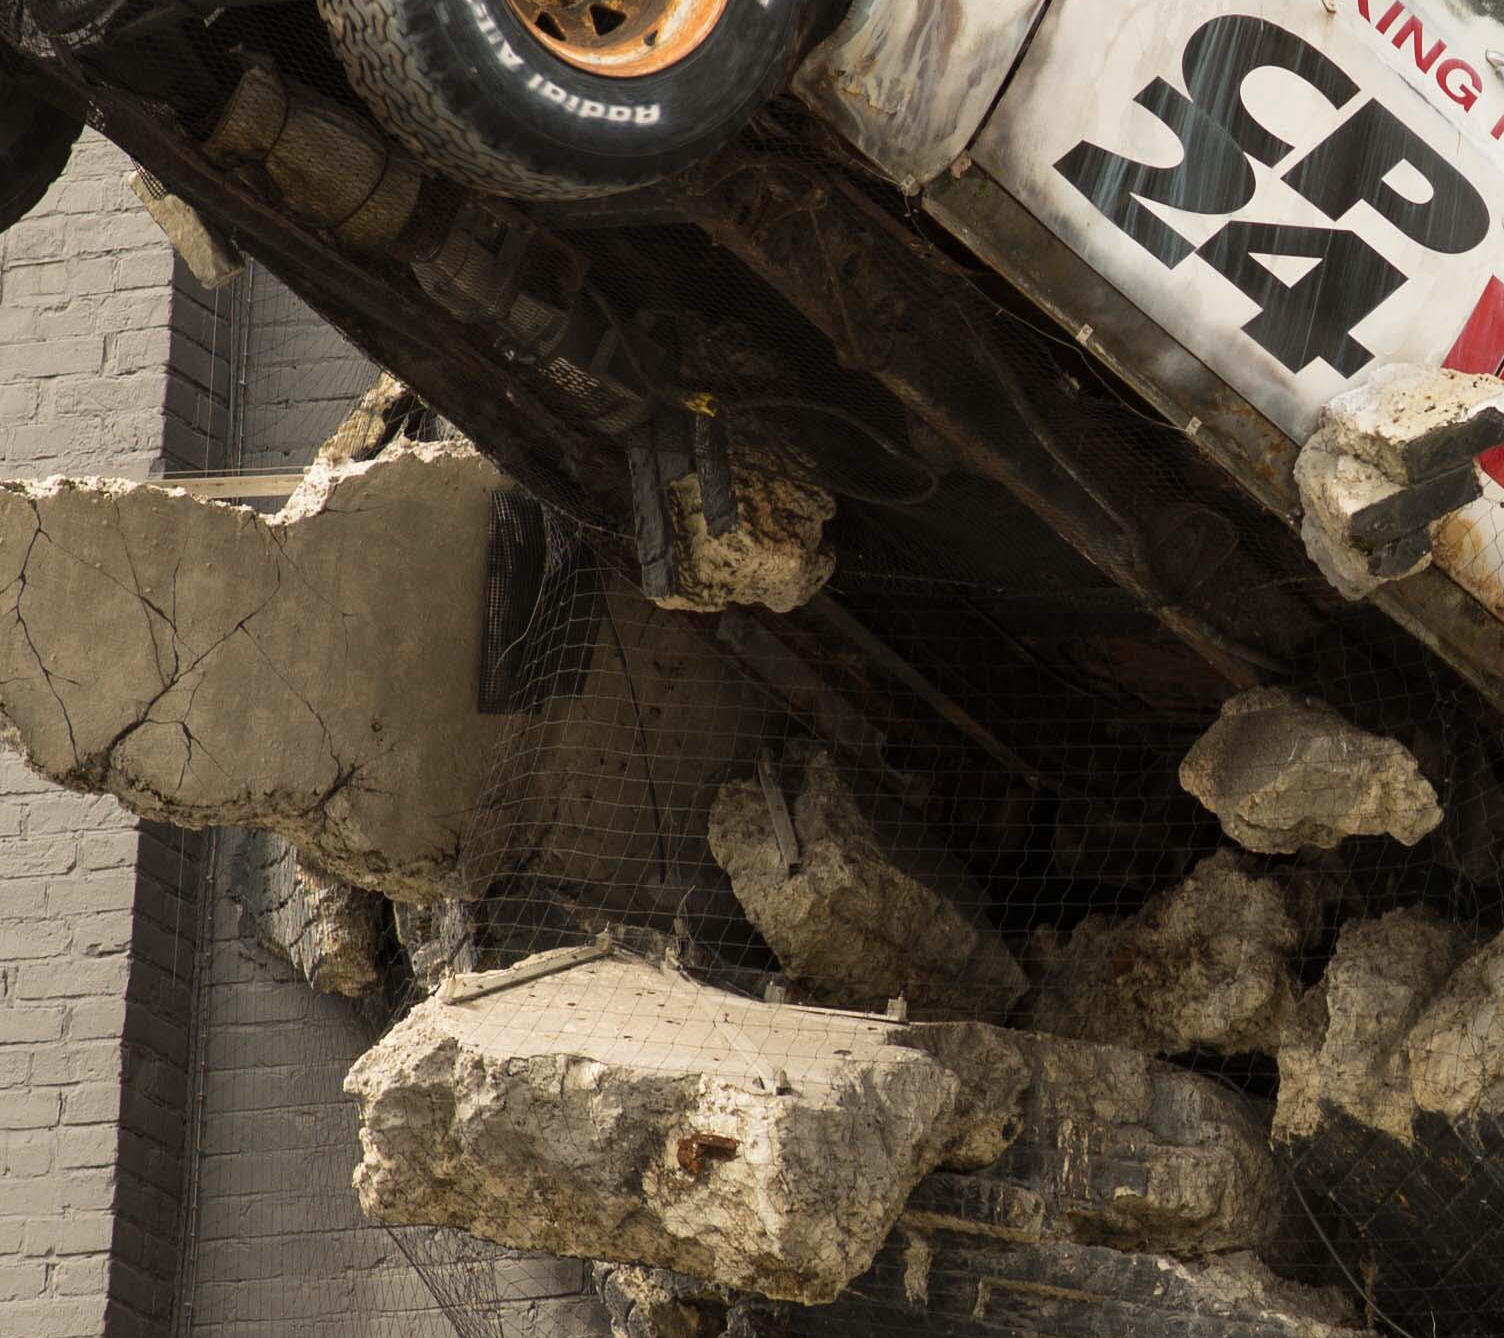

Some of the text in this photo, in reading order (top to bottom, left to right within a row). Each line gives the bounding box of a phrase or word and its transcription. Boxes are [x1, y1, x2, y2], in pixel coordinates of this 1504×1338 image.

[527, 73, 661, 126] Radial
[1181, 14, 1490, 254] CP
[1052, 75, 1409, 380] 24
